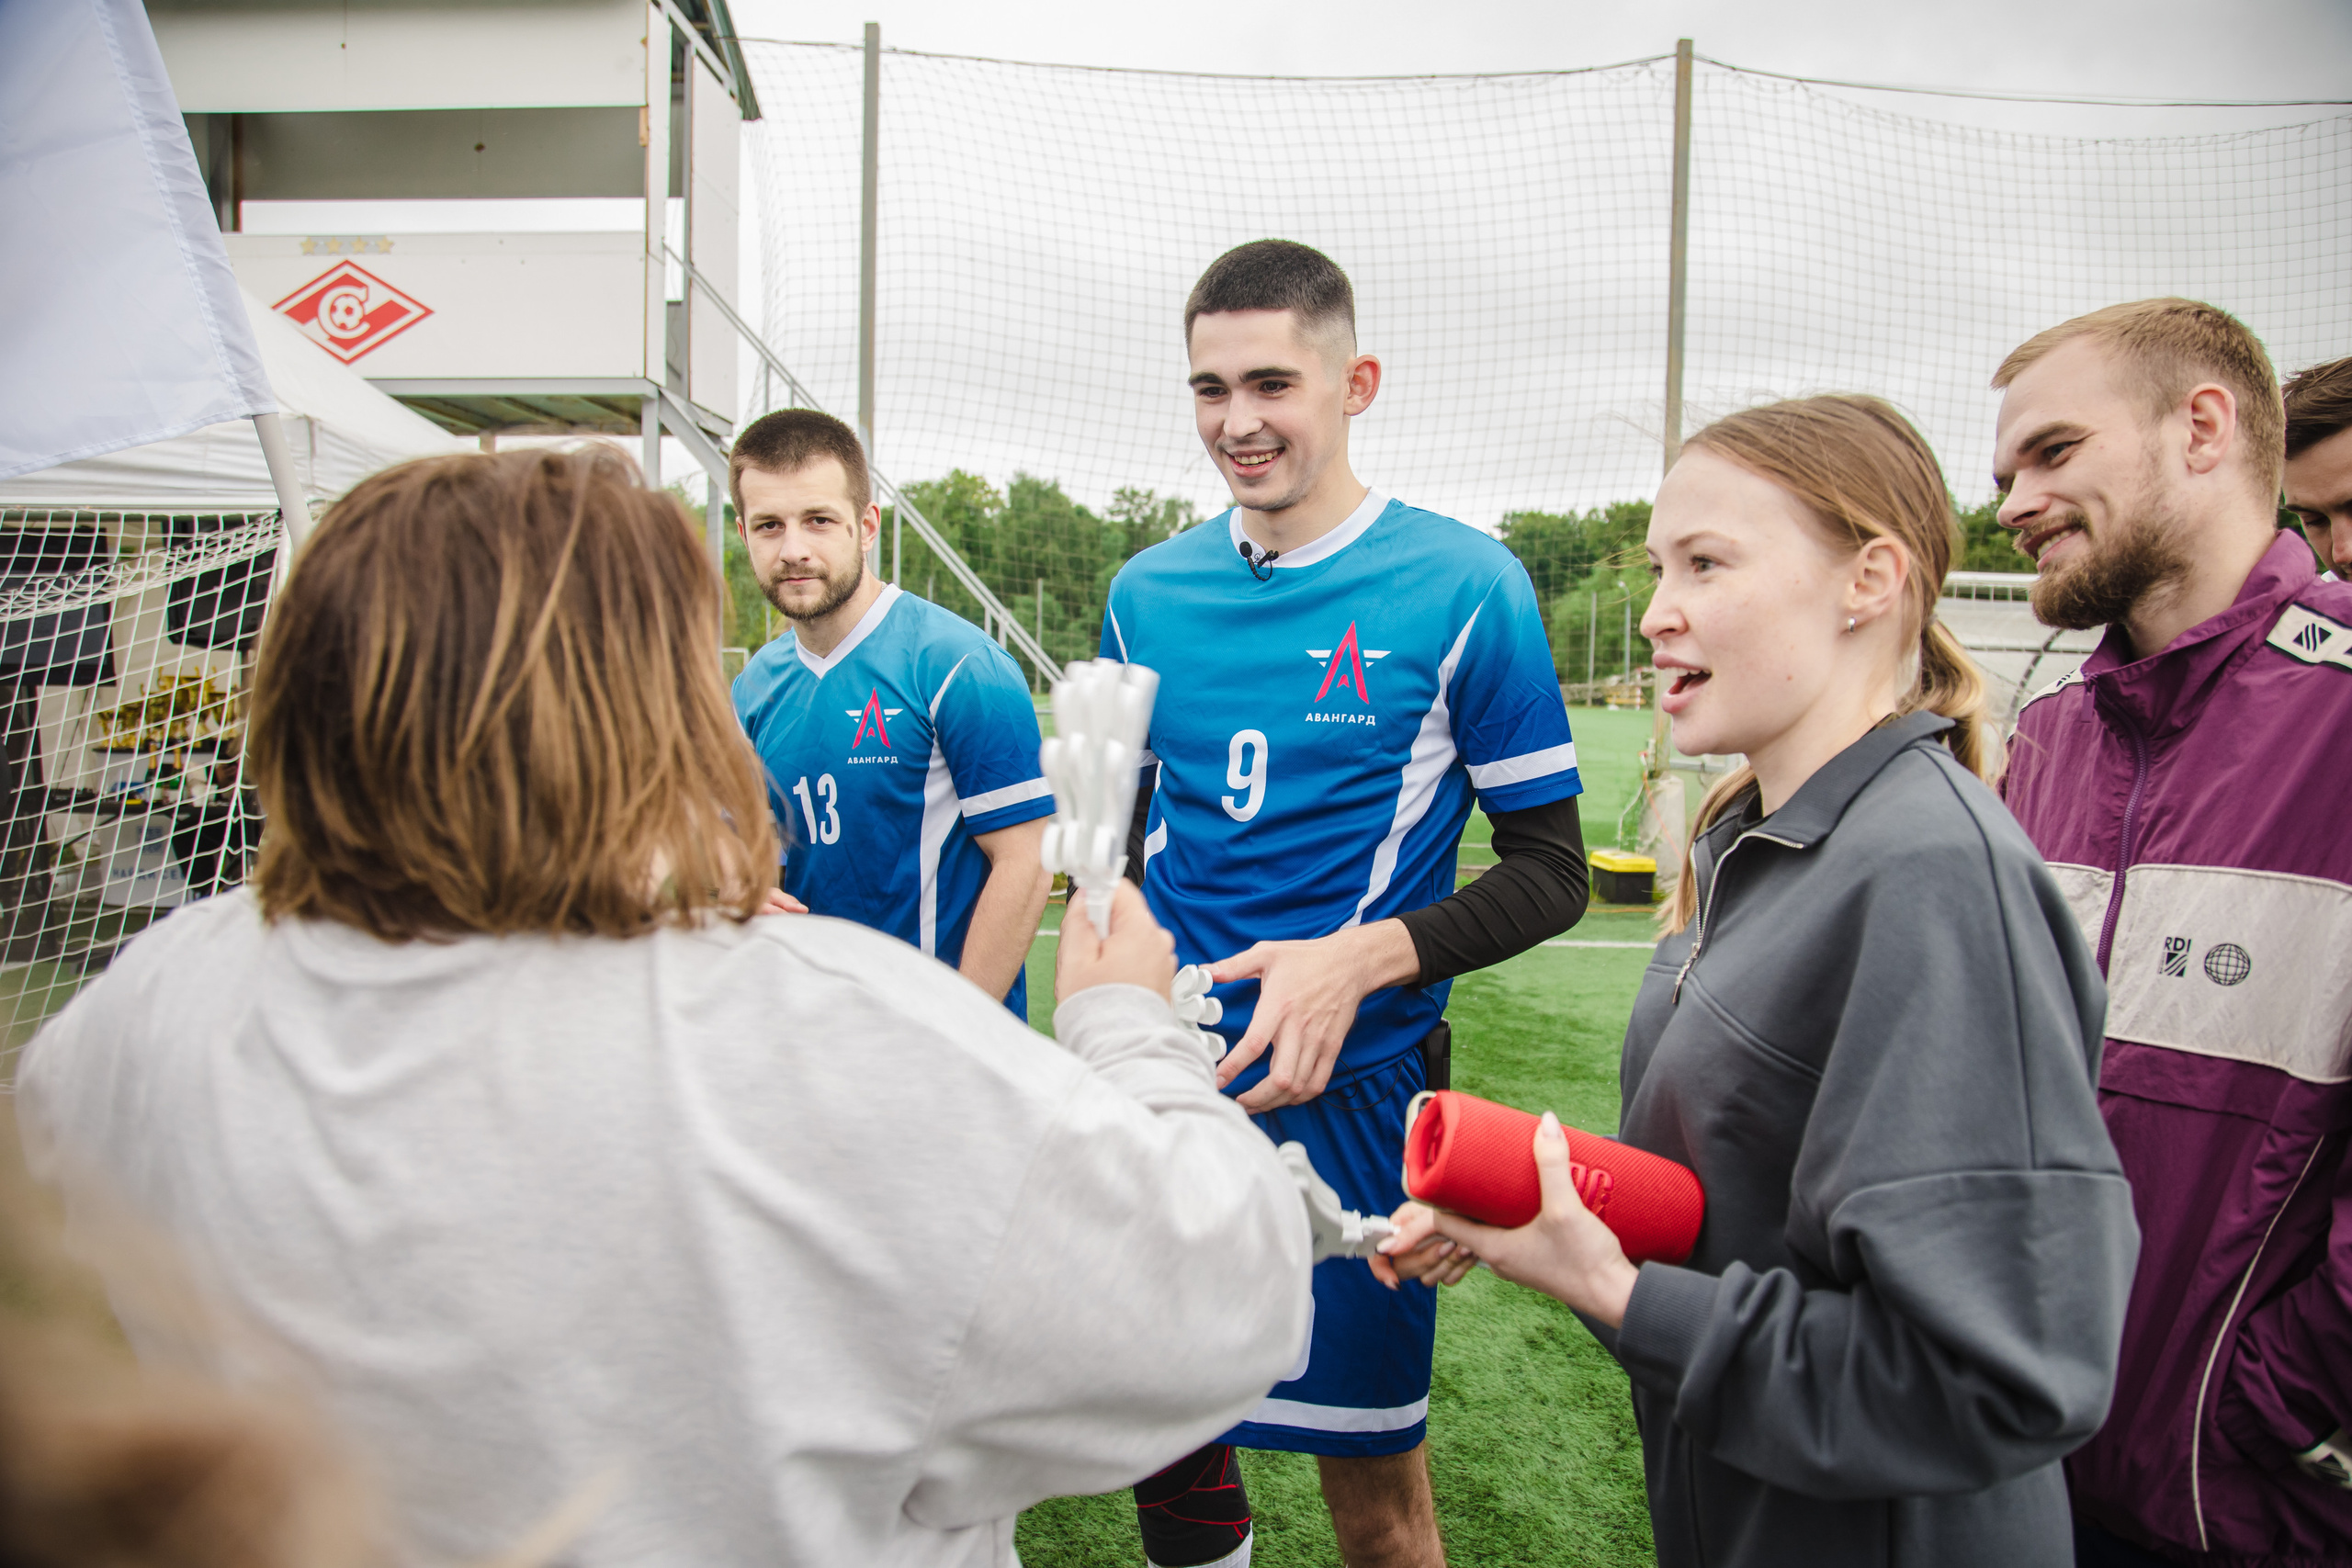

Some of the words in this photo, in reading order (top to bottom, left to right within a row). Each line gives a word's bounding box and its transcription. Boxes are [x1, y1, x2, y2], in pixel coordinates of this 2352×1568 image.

[1305, 712, 1376, 727] АВАНГАРД
[847, 756, 899, 764] АВАНГАРД
[1221, 728, 1269, 823] 9
[792, 773, 841, 845] 13
[2164, 936, 2191, 953] RDI
